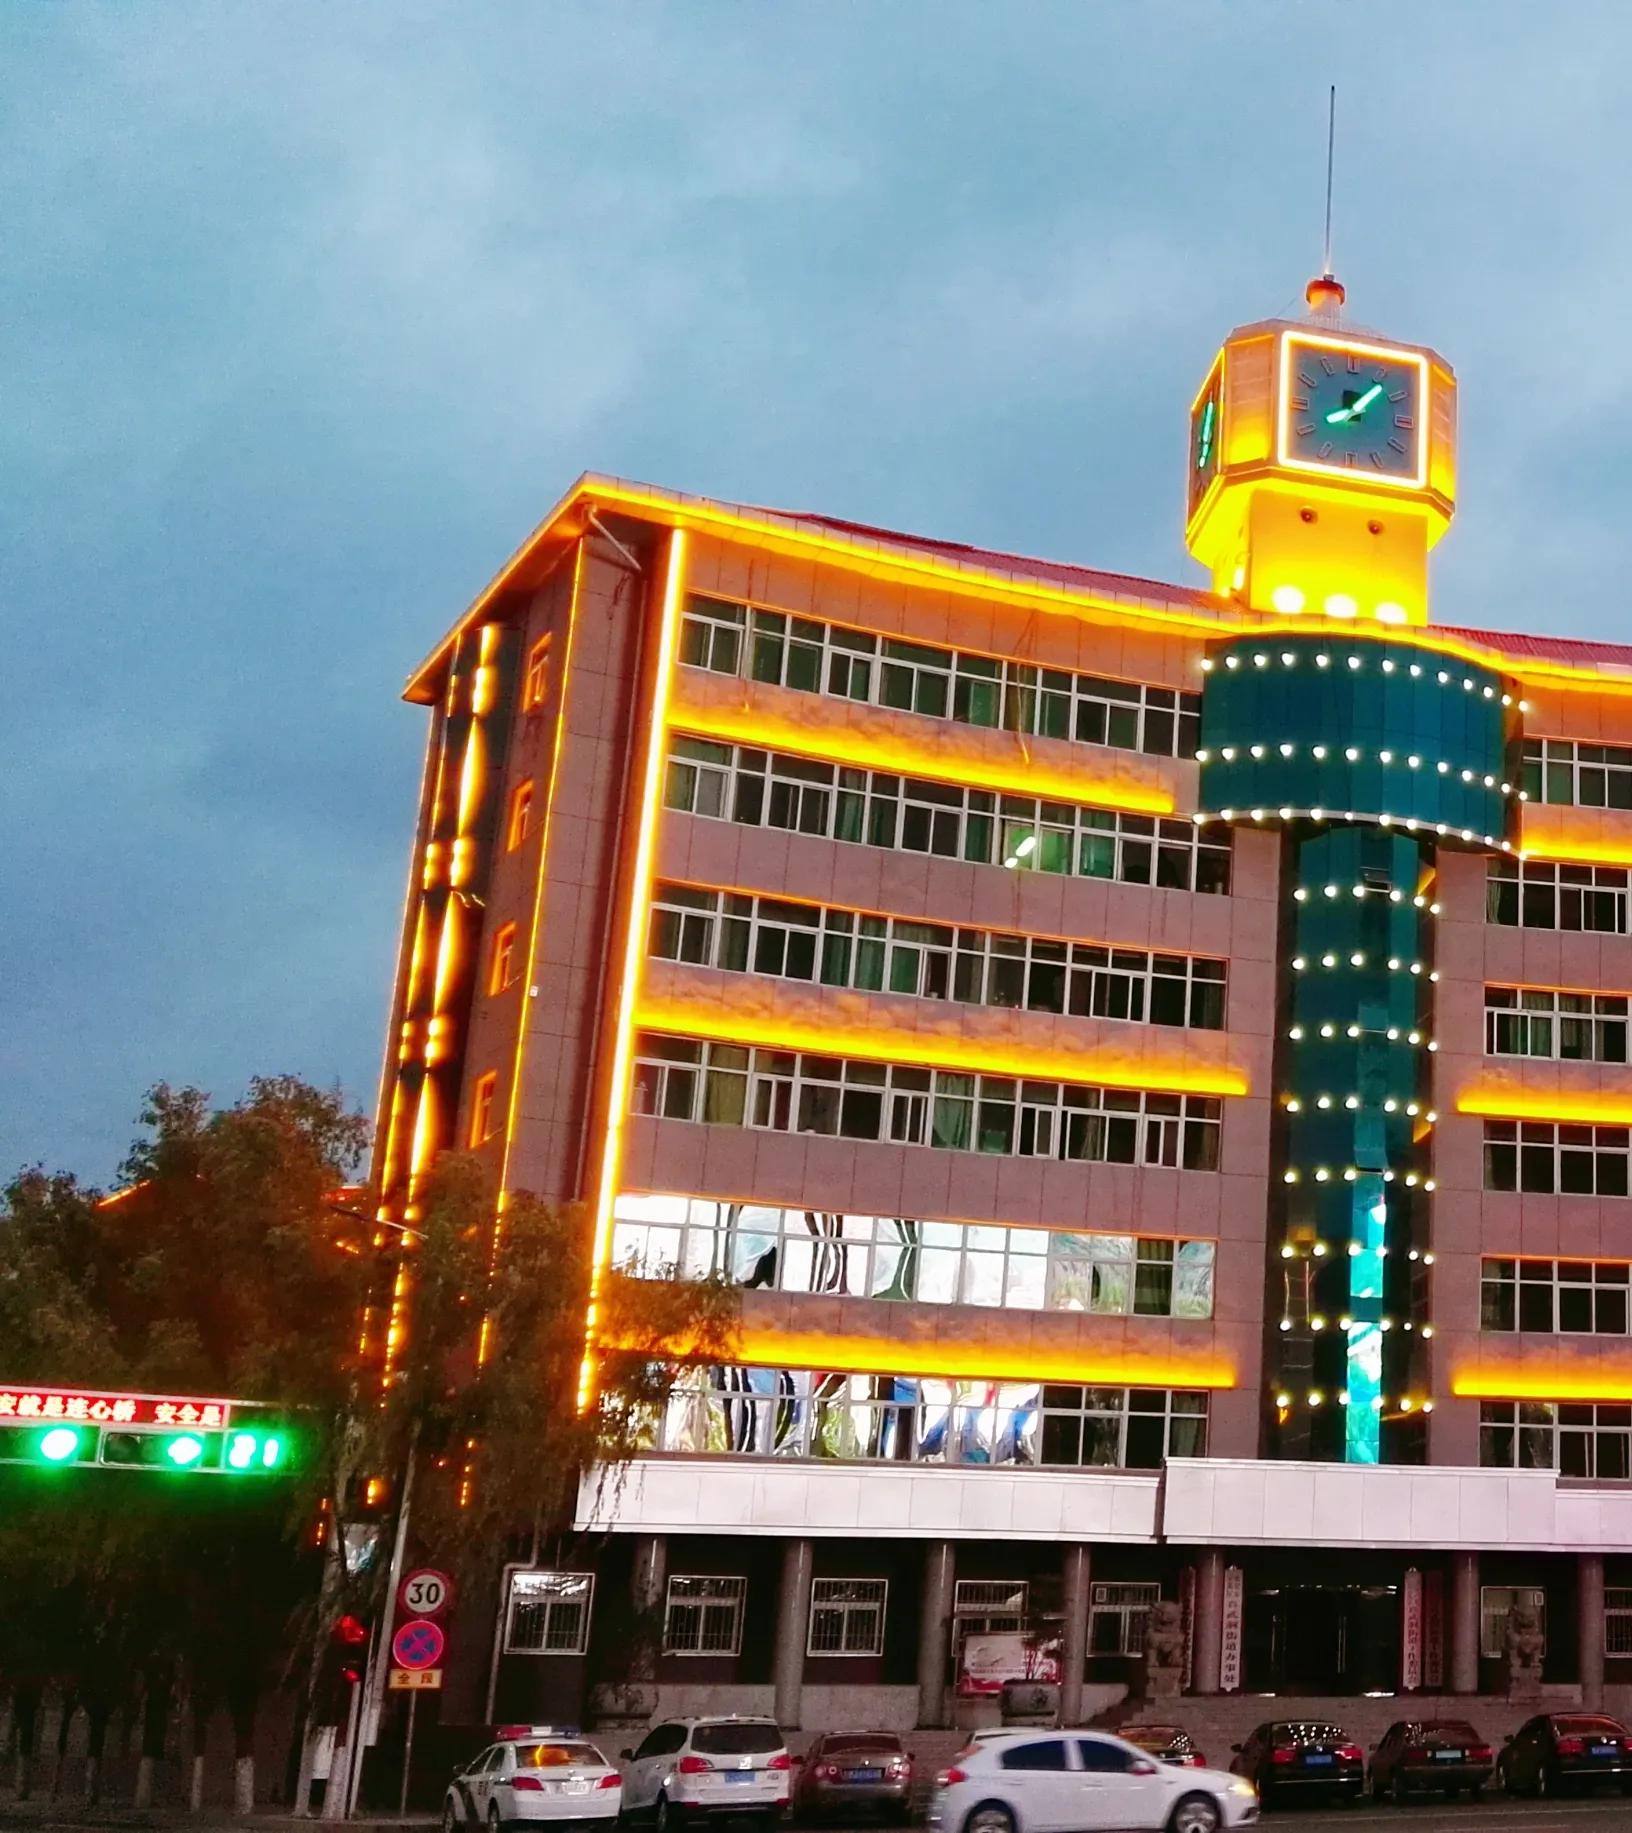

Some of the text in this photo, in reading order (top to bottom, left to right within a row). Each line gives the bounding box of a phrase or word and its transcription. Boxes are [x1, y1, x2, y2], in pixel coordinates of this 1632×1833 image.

[154, 1402, 222, 1427] 安全是
[409, 1582, 441, 1605] 30
